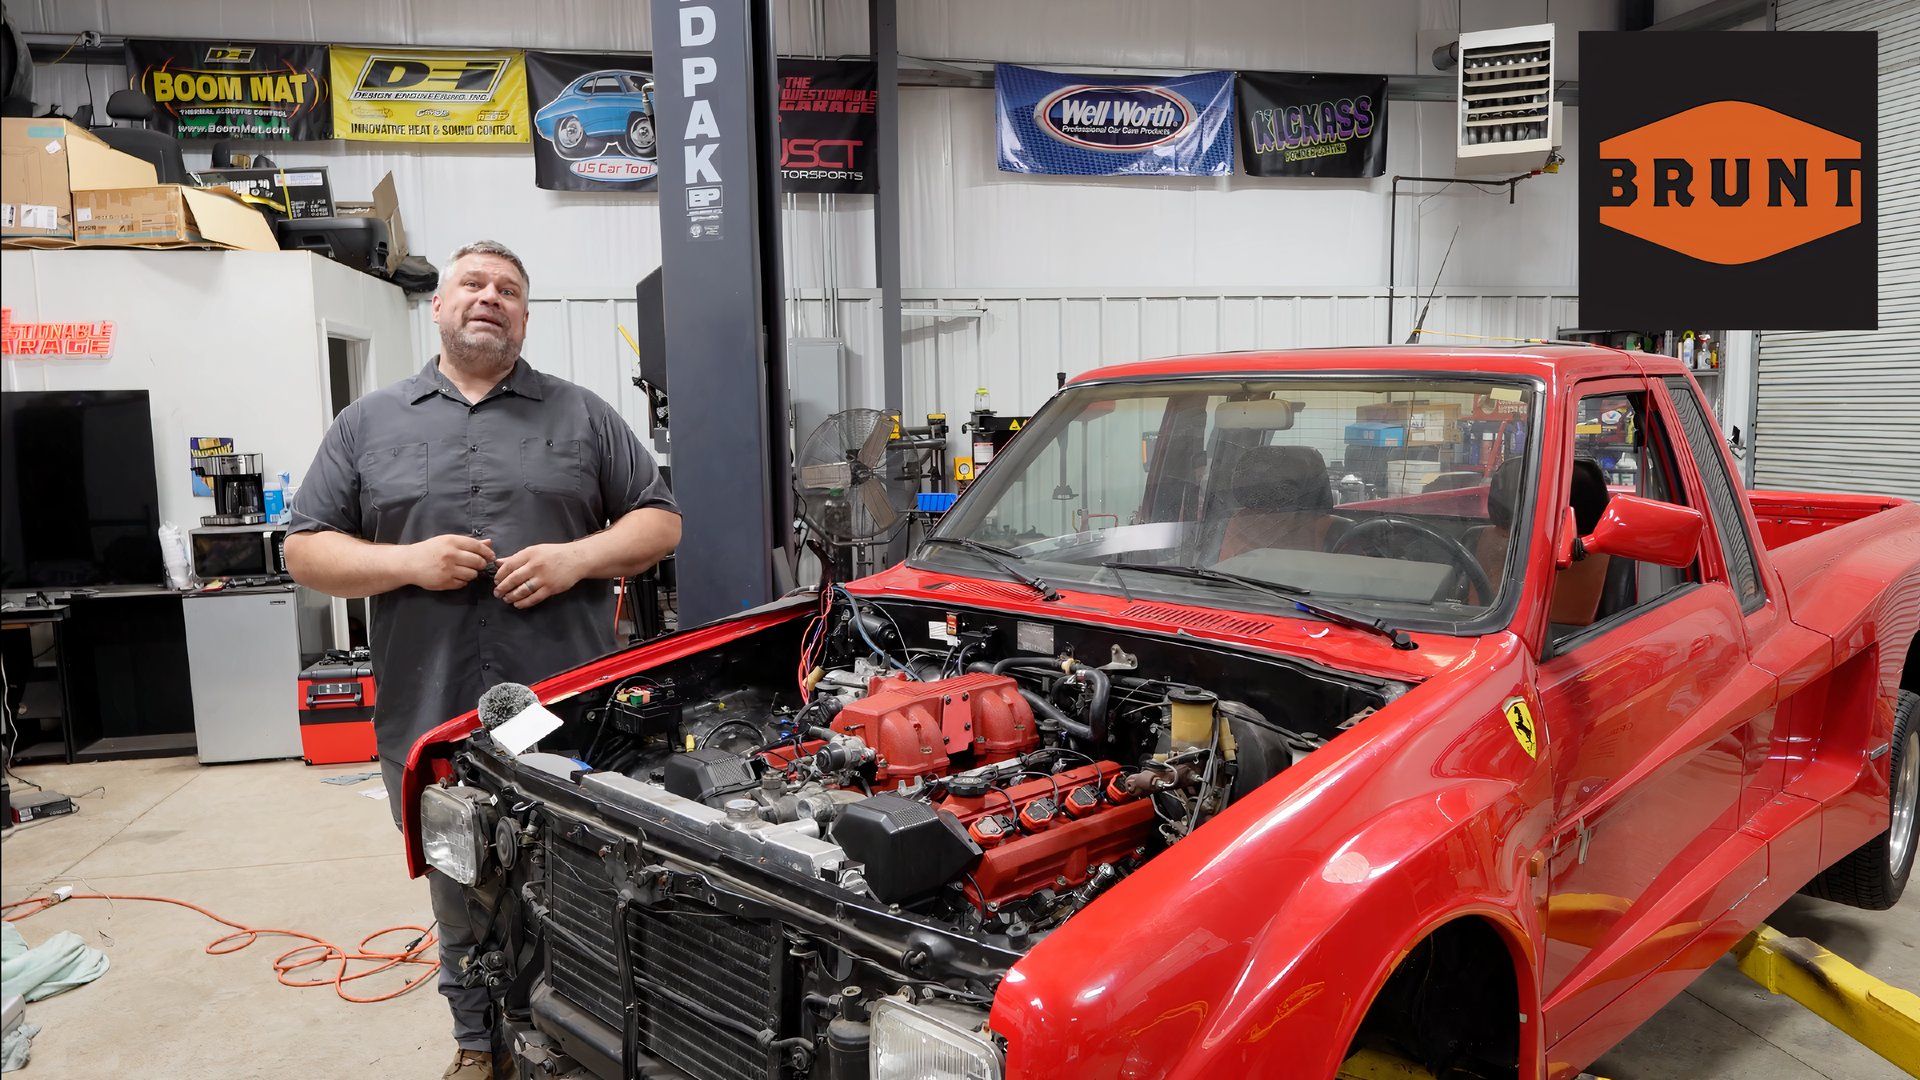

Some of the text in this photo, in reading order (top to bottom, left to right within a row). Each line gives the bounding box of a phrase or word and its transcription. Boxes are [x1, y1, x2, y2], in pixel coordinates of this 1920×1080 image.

[153, 71, 307, 104] BOOM MAT
[785, 76, 811, 89] THE
[353, 91, 393, 99] DESIGN
[679, 0, 722, 184] DPAK
[781, 88, 877, 102] QUESTIONABLE
[253, 108, 287, 118] CONTROL
[779, 100, 876, 114] GARAGE
[1062, 99, 1176, 127] Well Worth
[178, 122, 290, 135] www.BoomMat.com
[351, 123, 406, 135] INNOVATIVE
[408, 124, 431, 135] HEAT
[442, 124, 474, 136] SOUND
[476, 125, 518, 136] CONTROL
[1062, 125, 1107, 134] Professional
[1108, 126, 1121, 134] Car
[1140, 127, 1171, 136] Products
[1251, 95, 1375, 154] KICKASS
[577, 163, 652, 174] US Car Tool
